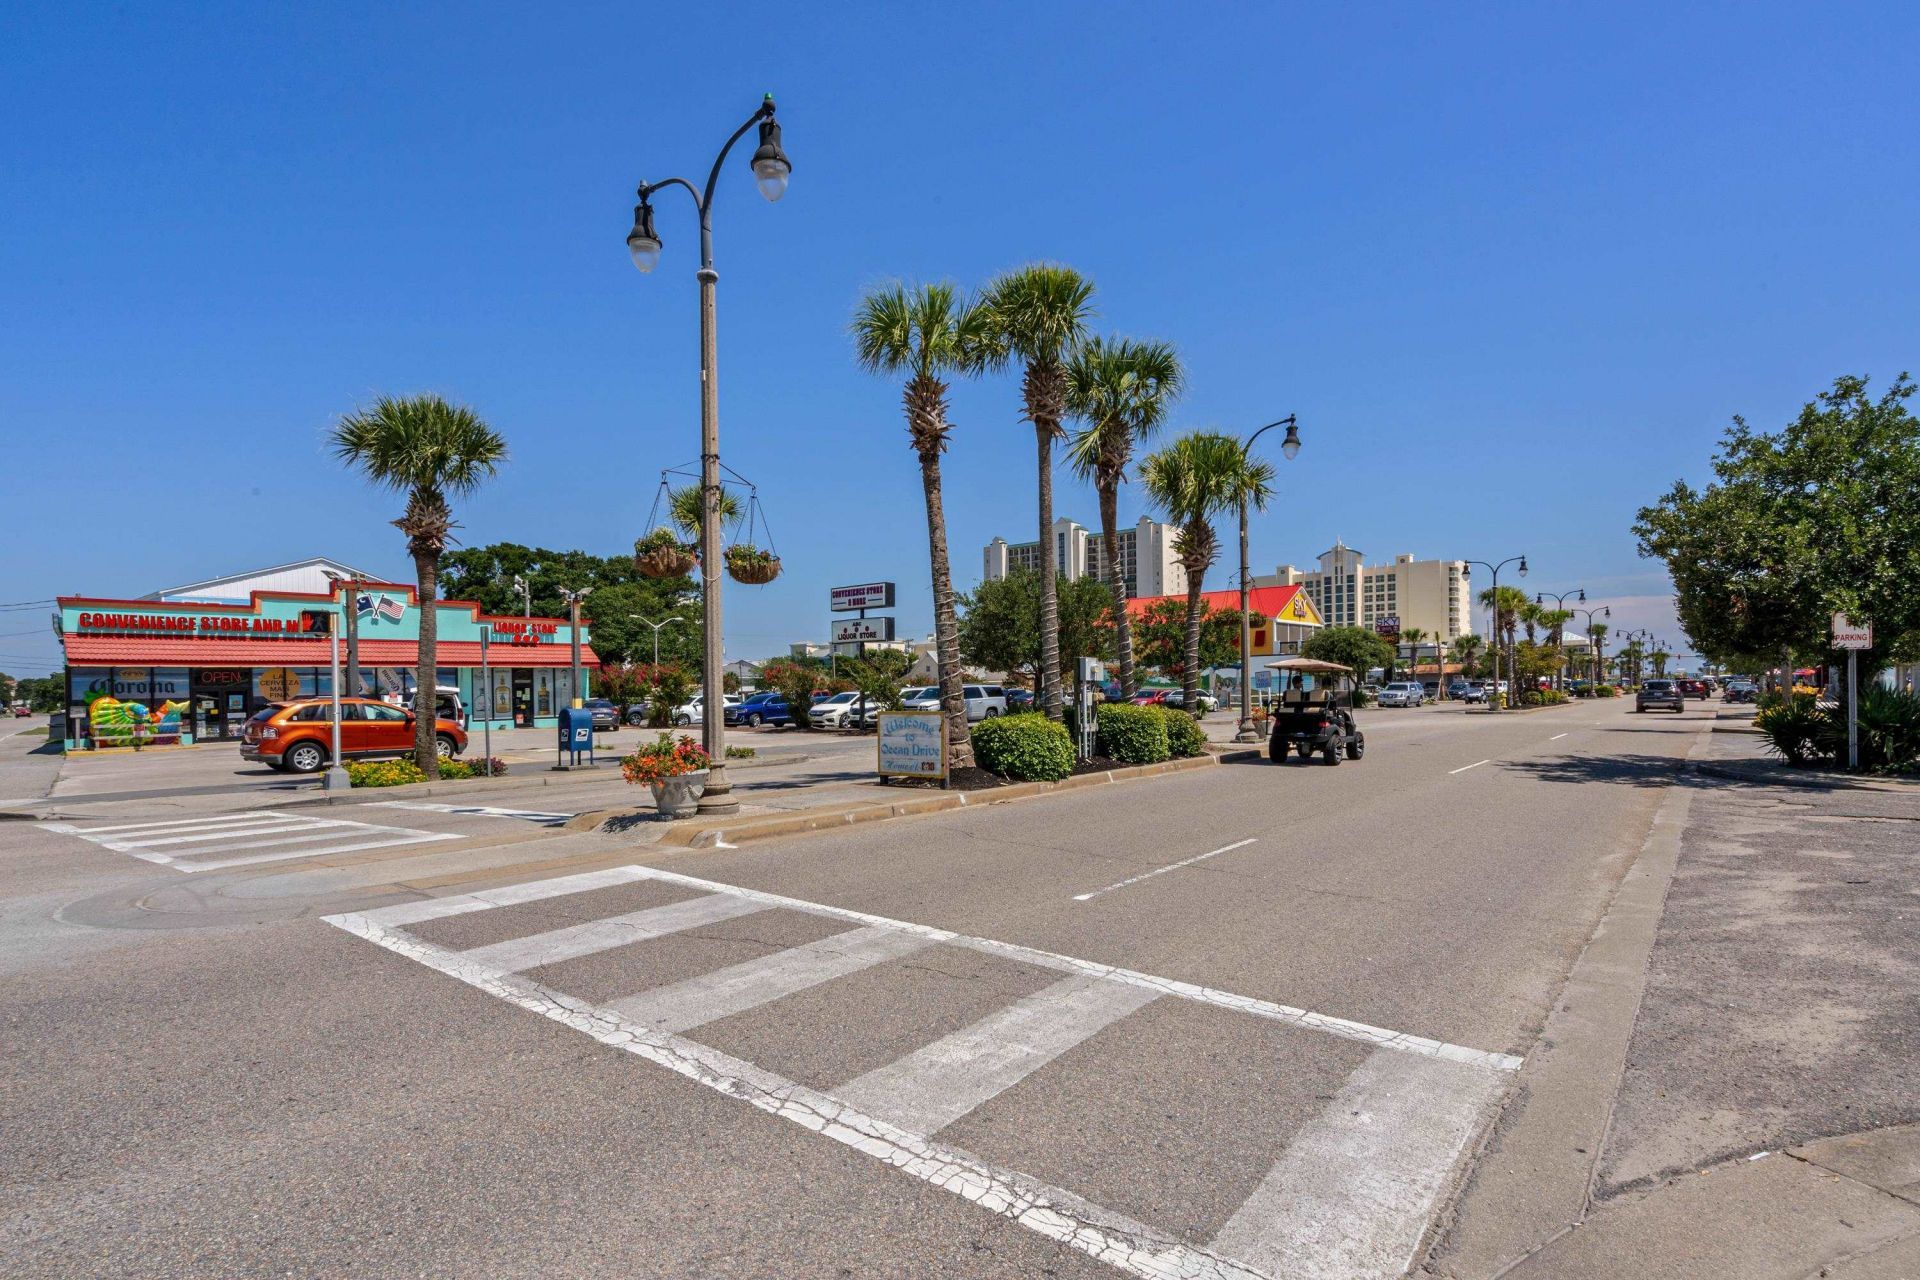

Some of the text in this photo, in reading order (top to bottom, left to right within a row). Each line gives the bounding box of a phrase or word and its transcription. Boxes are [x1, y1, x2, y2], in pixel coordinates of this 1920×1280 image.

[832, 586, 883, 599] CONVENIENCE STORE
[852, 597, 866, 606] MORE
[1294, 597, 1307, 610] SKY
[79, 612, 196, 631] CONVENIENCE
[200, 616, 249, 631] STORE
[252, 618, 283, 632] AND
[1376, 617, 1398, 626] SKY
[493, 622, 558, 634] LIQUOR STORE
[837, 631, 877, 640] LIQUOR STORE
[1835, 633, 1868, 641] PARKING
[202, 671, 242, 682] OPEN
[89, 679, 176, 694] Corona
[884, 717, 934, 736] Welcome
[905, 733, 915, 741] to
[881, 744, 940, 756] Ocean Drive
